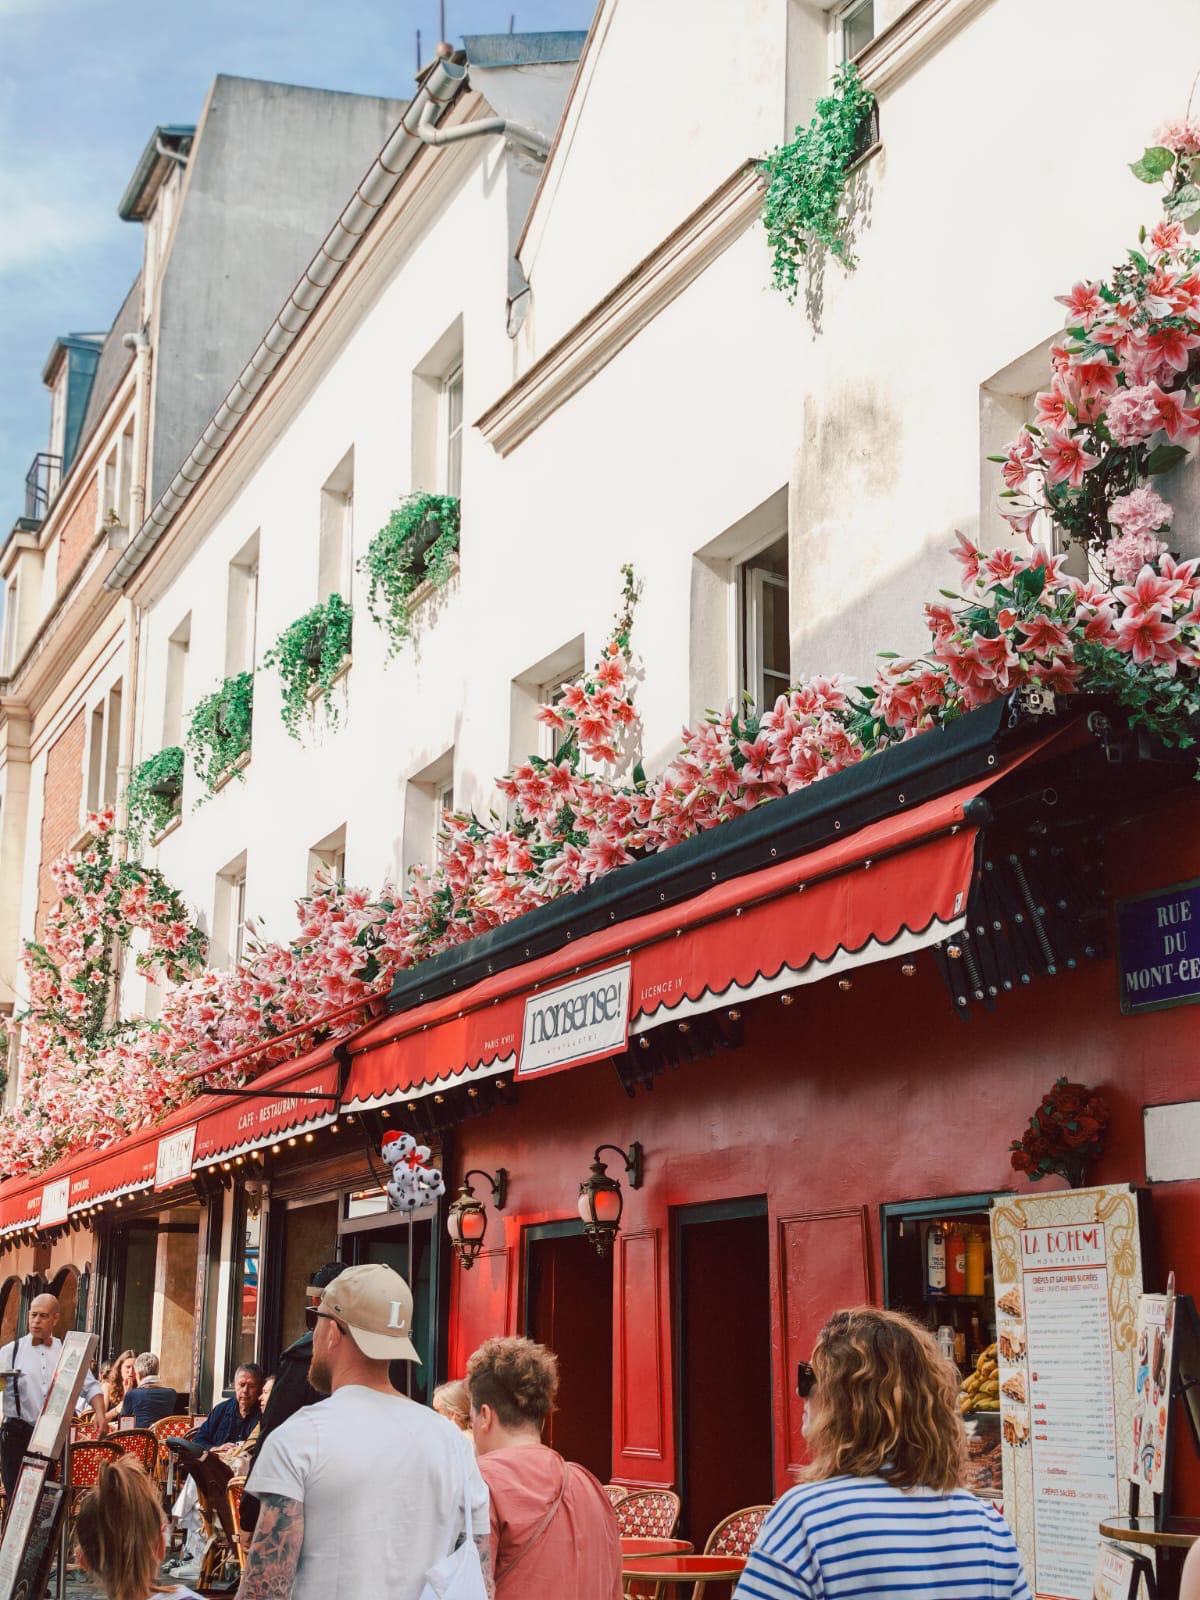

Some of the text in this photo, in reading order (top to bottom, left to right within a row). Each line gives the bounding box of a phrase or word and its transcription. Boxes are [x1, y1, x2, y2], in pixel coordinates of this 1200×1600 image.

[1157, 900, 1192, 928] RUE
[1164, 931, 1187, 955] DU
[1126, 957, 1200, 992] MONT-CE
[641, 977, 683, 1000] LICENCE IV
[529, 980, 622, 1046] nonsense!
[238, 1112, 255, 1130] CAFE
[1024, 1234, 1040, 1255] LA
[387, 1301, 405, 1329] L
